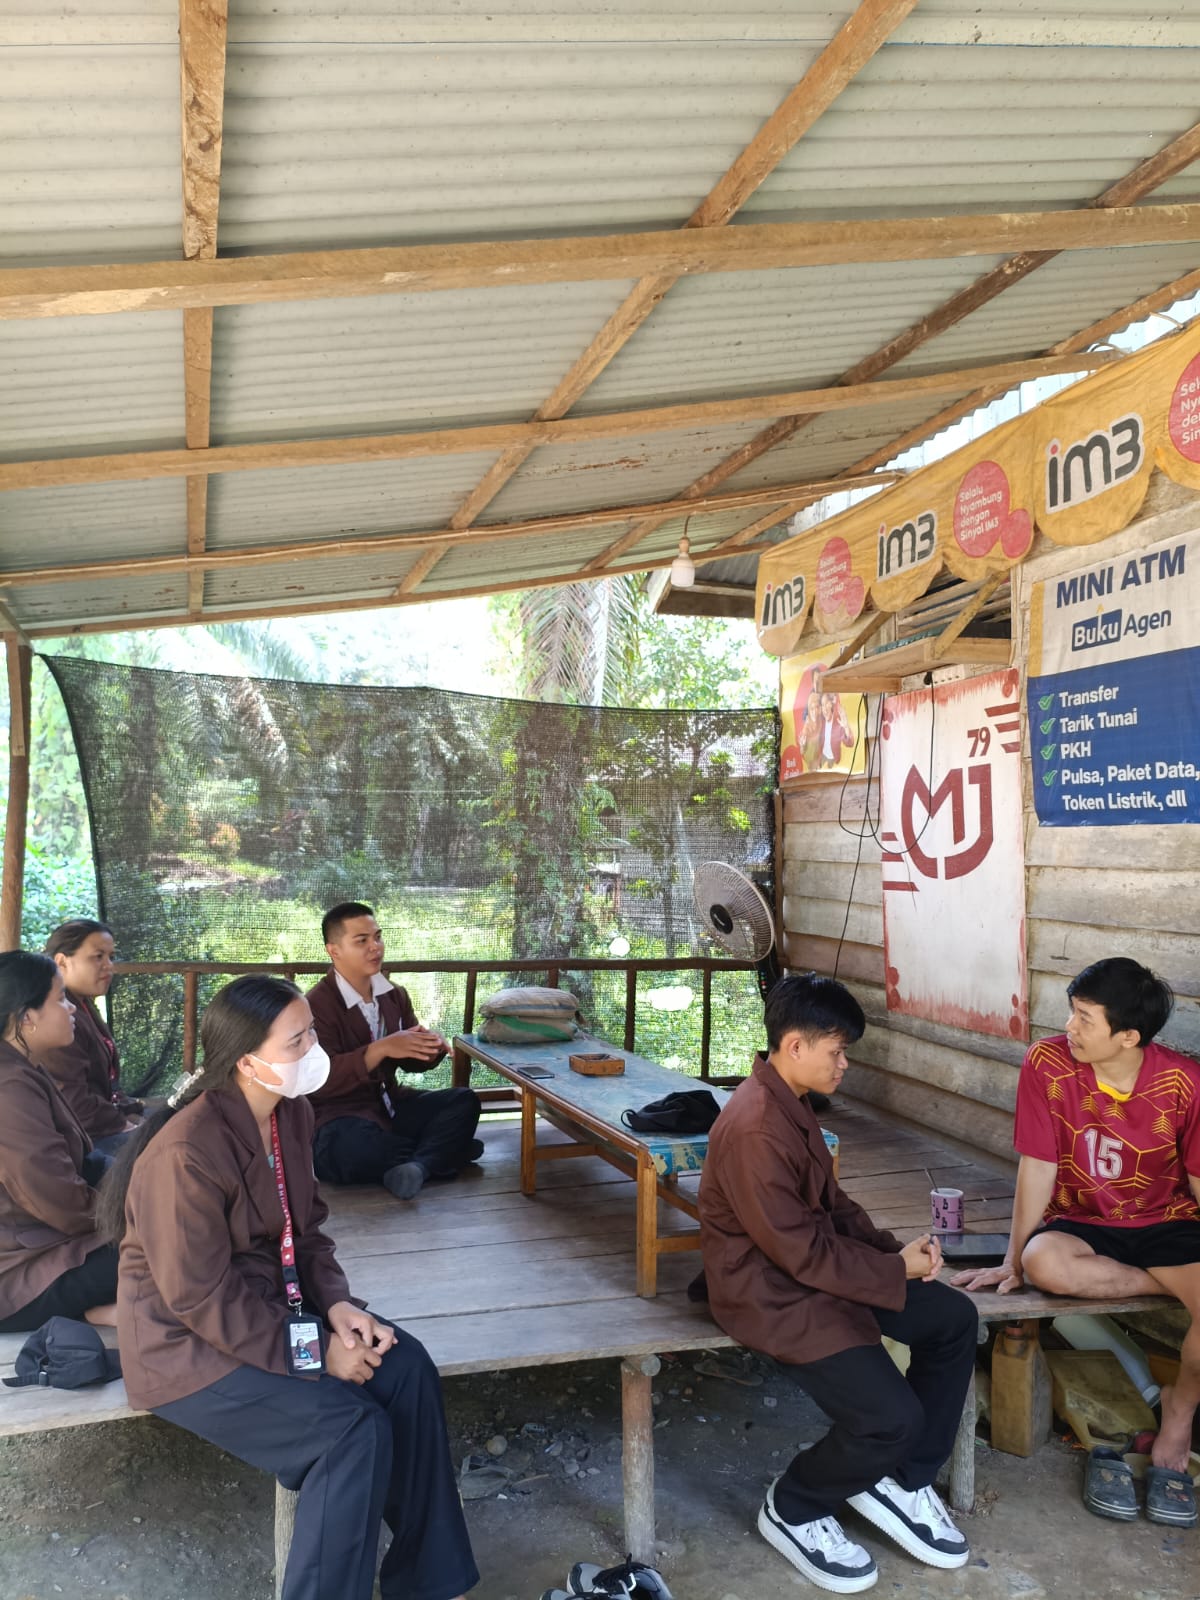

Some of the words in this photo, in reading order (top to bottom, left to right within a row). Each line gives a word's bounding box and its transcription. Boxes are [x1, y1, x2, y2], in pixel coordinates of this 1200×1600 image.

[1182, 412, 1200, 428] de
[1048, 418, 1141, 509] im3
[960, 491, 1003, 517] Nyambung
[960, 510, 990, 527] dengan
[877, 512, 936, 577] im3
[960, 523, 984, 541] Sinyal
[1056, 566, 1114, 608] MINI
[1120, 544, 1186, 590] ATM
[762, 576, 806, 627] im3
[1074, 615, 1119, 648] Buku
[1124, 609, 1171, 637] Agen
[1059, 685, 1119, 708] Transfer
[1060, 715, 1095, 733] Tarik
[1097, 708, 1137, 729] Tunai
[967, 726, 991, 758] 79
[1060, 741, 1091, 760] PKH
[1061, 767, 1104, 786] Pulsa,
[1107, 762, 1151, 783] Paket
[1155, 761, 1200, 781] Data,
[1062, 793, 1105, 811] Token
[1107, 792, 1164, 811] Listrik,
[1165, 789, 1187, 808] dll
[1084, 1128, 1123, 1179] 15
